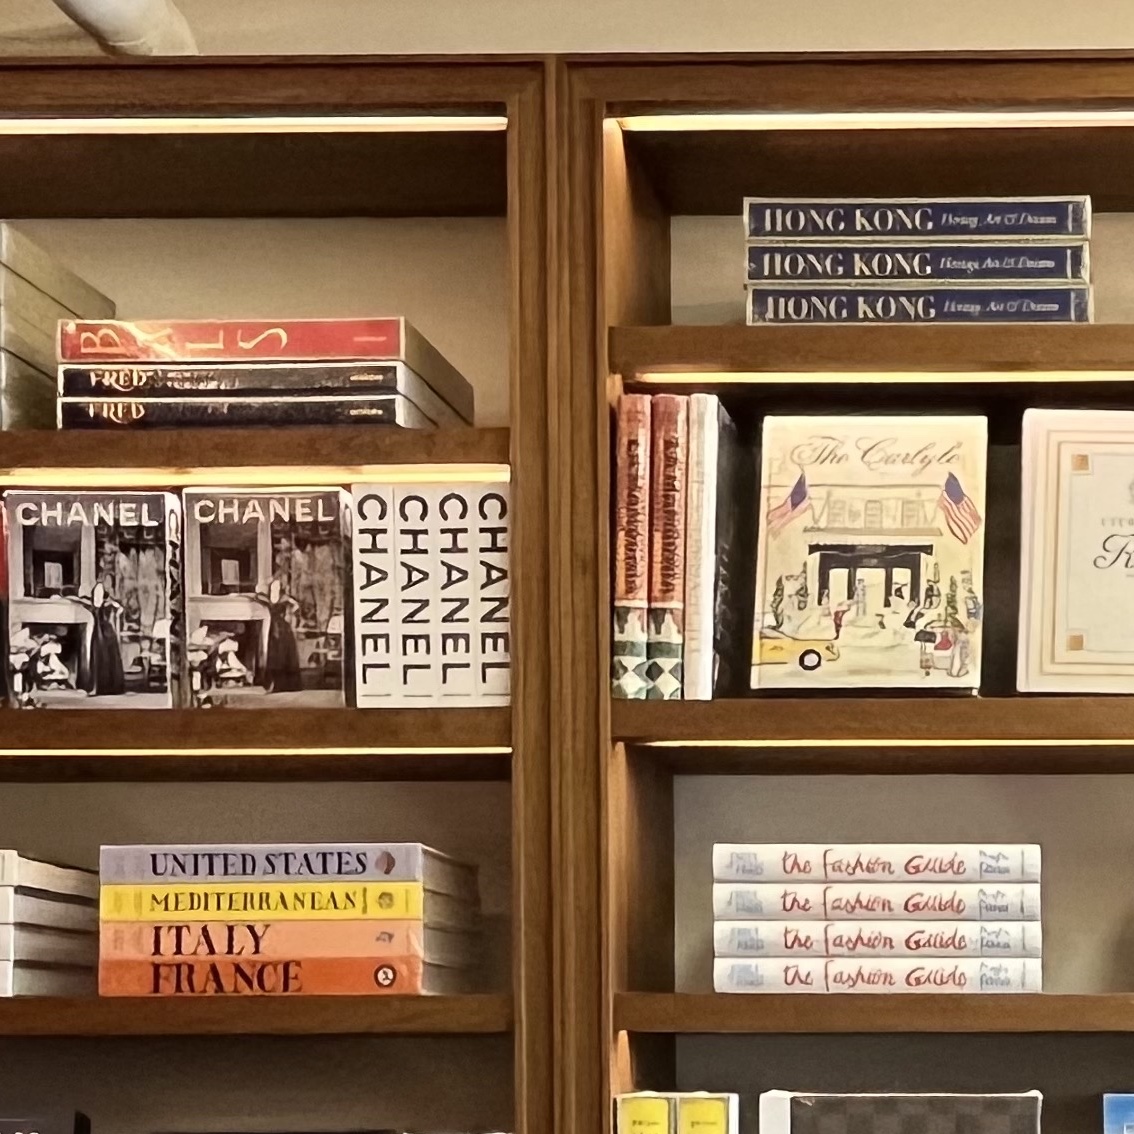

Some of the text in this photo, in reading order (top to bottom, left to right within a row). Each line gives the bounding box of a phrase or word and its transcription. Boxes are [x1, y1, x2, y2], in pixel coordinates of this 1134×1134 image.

[764, 208, 845, 232] HONG
[855, 208, 934, 232] KONG
[762, 252, 844, 277] HONG
[854, 252, 932, 277] KONG
[767, 295, 848, 321] HONG
[857, 295, 936, 321] KONG
[790, 436, 963, 476] The Carlyle
[16, 502, 159, 527] CHANEL
[194, 498, 334, 524] CHANEL
[357, 494, 391, 685] CHANEL
[400, 494, 432, 685] CHANEL
[438, 493, 471, 685] CHANEL
[478, 492, 510, 685] CHANEL
[150, 851, 368, 876] UNITED STATES
[782, 850, 813, 875] the
[904, 852, 967, 875] Guide
[150, 890, 358, 912] MEDITERRANEAN
[782, 890, 813, 912] the
[904, 889, 967, 913] Guide
[150, 924, 271, 956] ITALY
[782, 926, 813, 950] the
[904, 928, 967, 950] Guide
[150, 961, 303, 994] FRANCE
[782, 965, 813, 986] the
[904, 966, 967, 987] Guide
